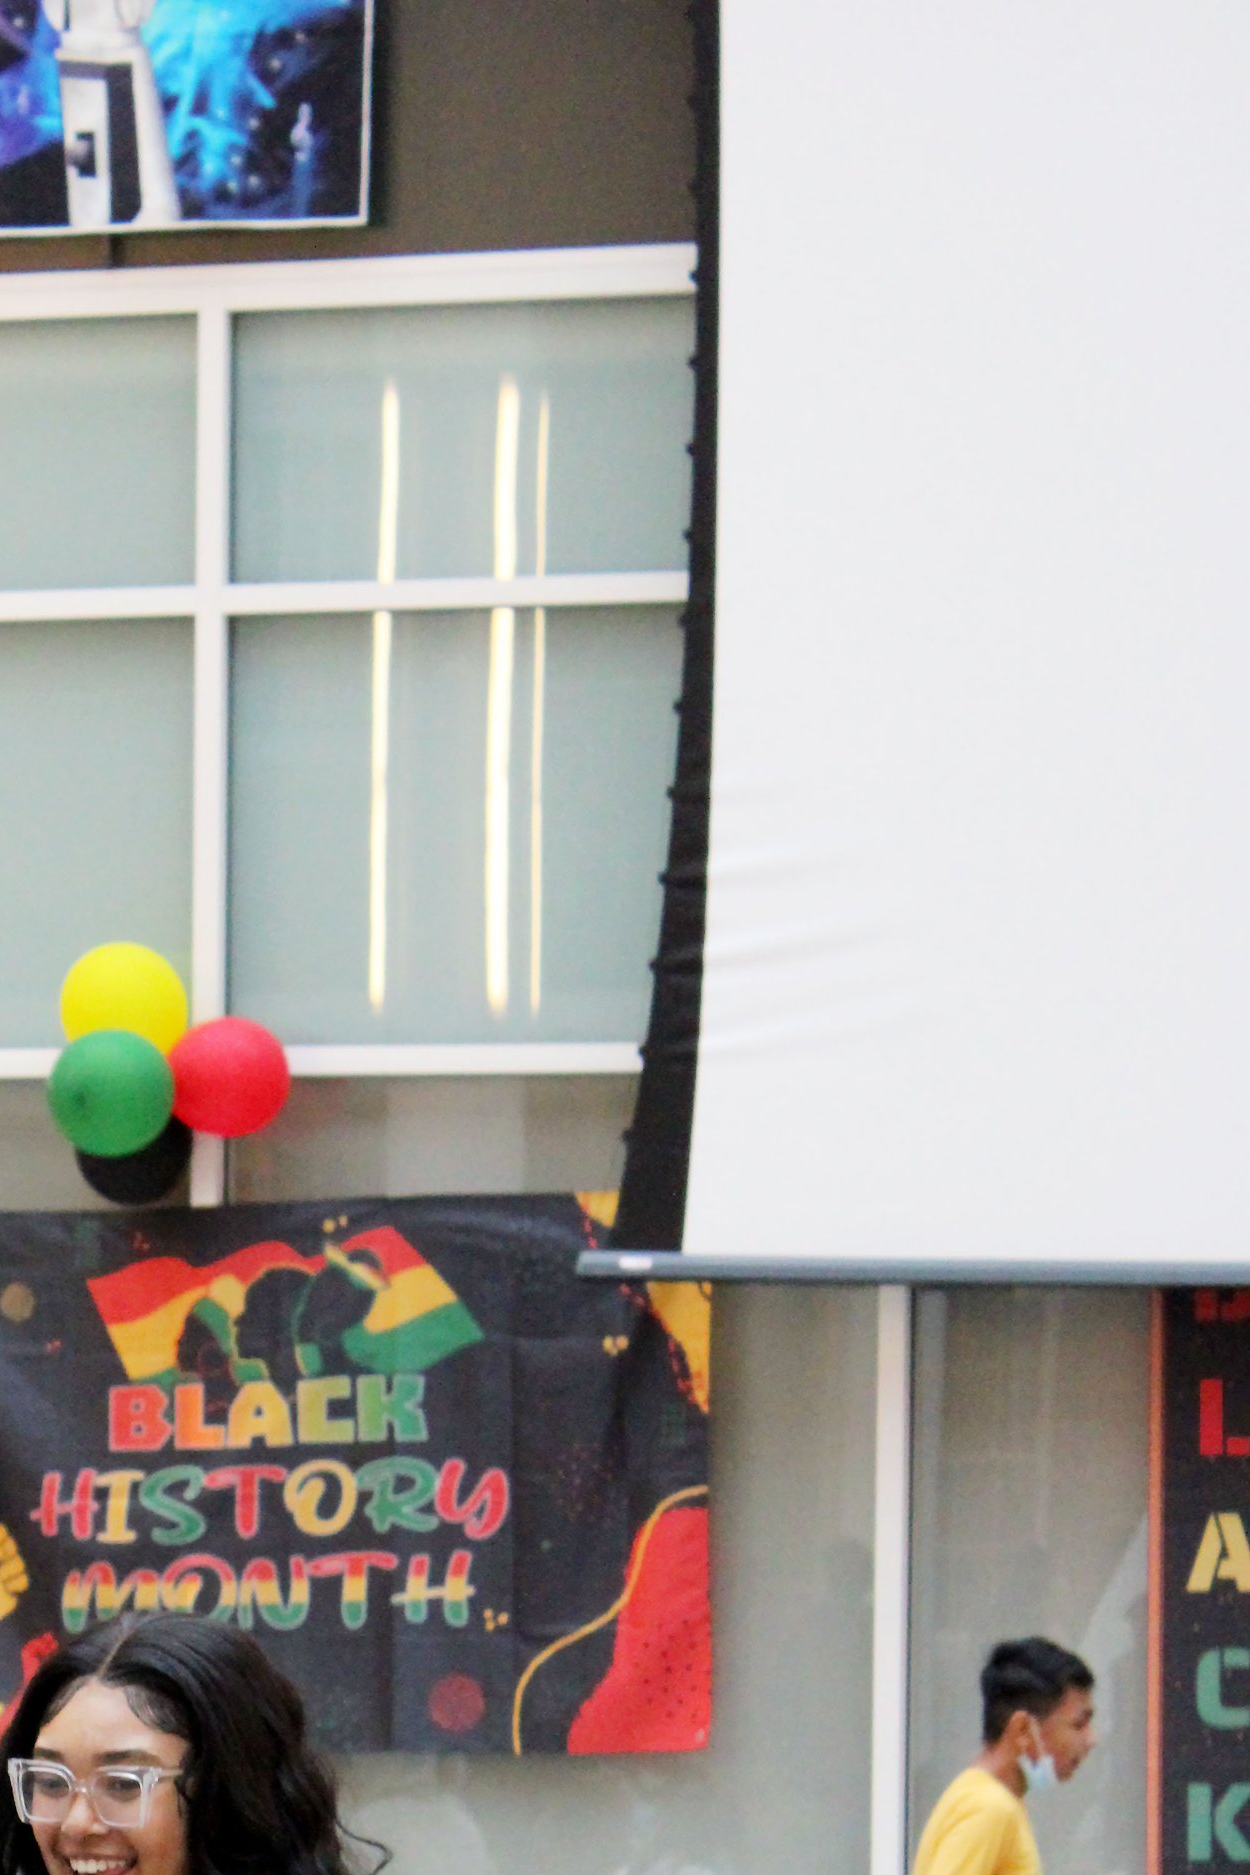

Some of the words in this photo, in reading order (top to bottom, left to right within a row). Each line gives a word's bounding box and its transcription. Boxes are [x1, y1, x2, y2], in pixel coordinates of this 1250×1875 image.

[108, 1374, 428, 1451] BLACK
[30, 1456, 509, 1545] HISTORY
[61, 1550, 476, 1634] MONTH
